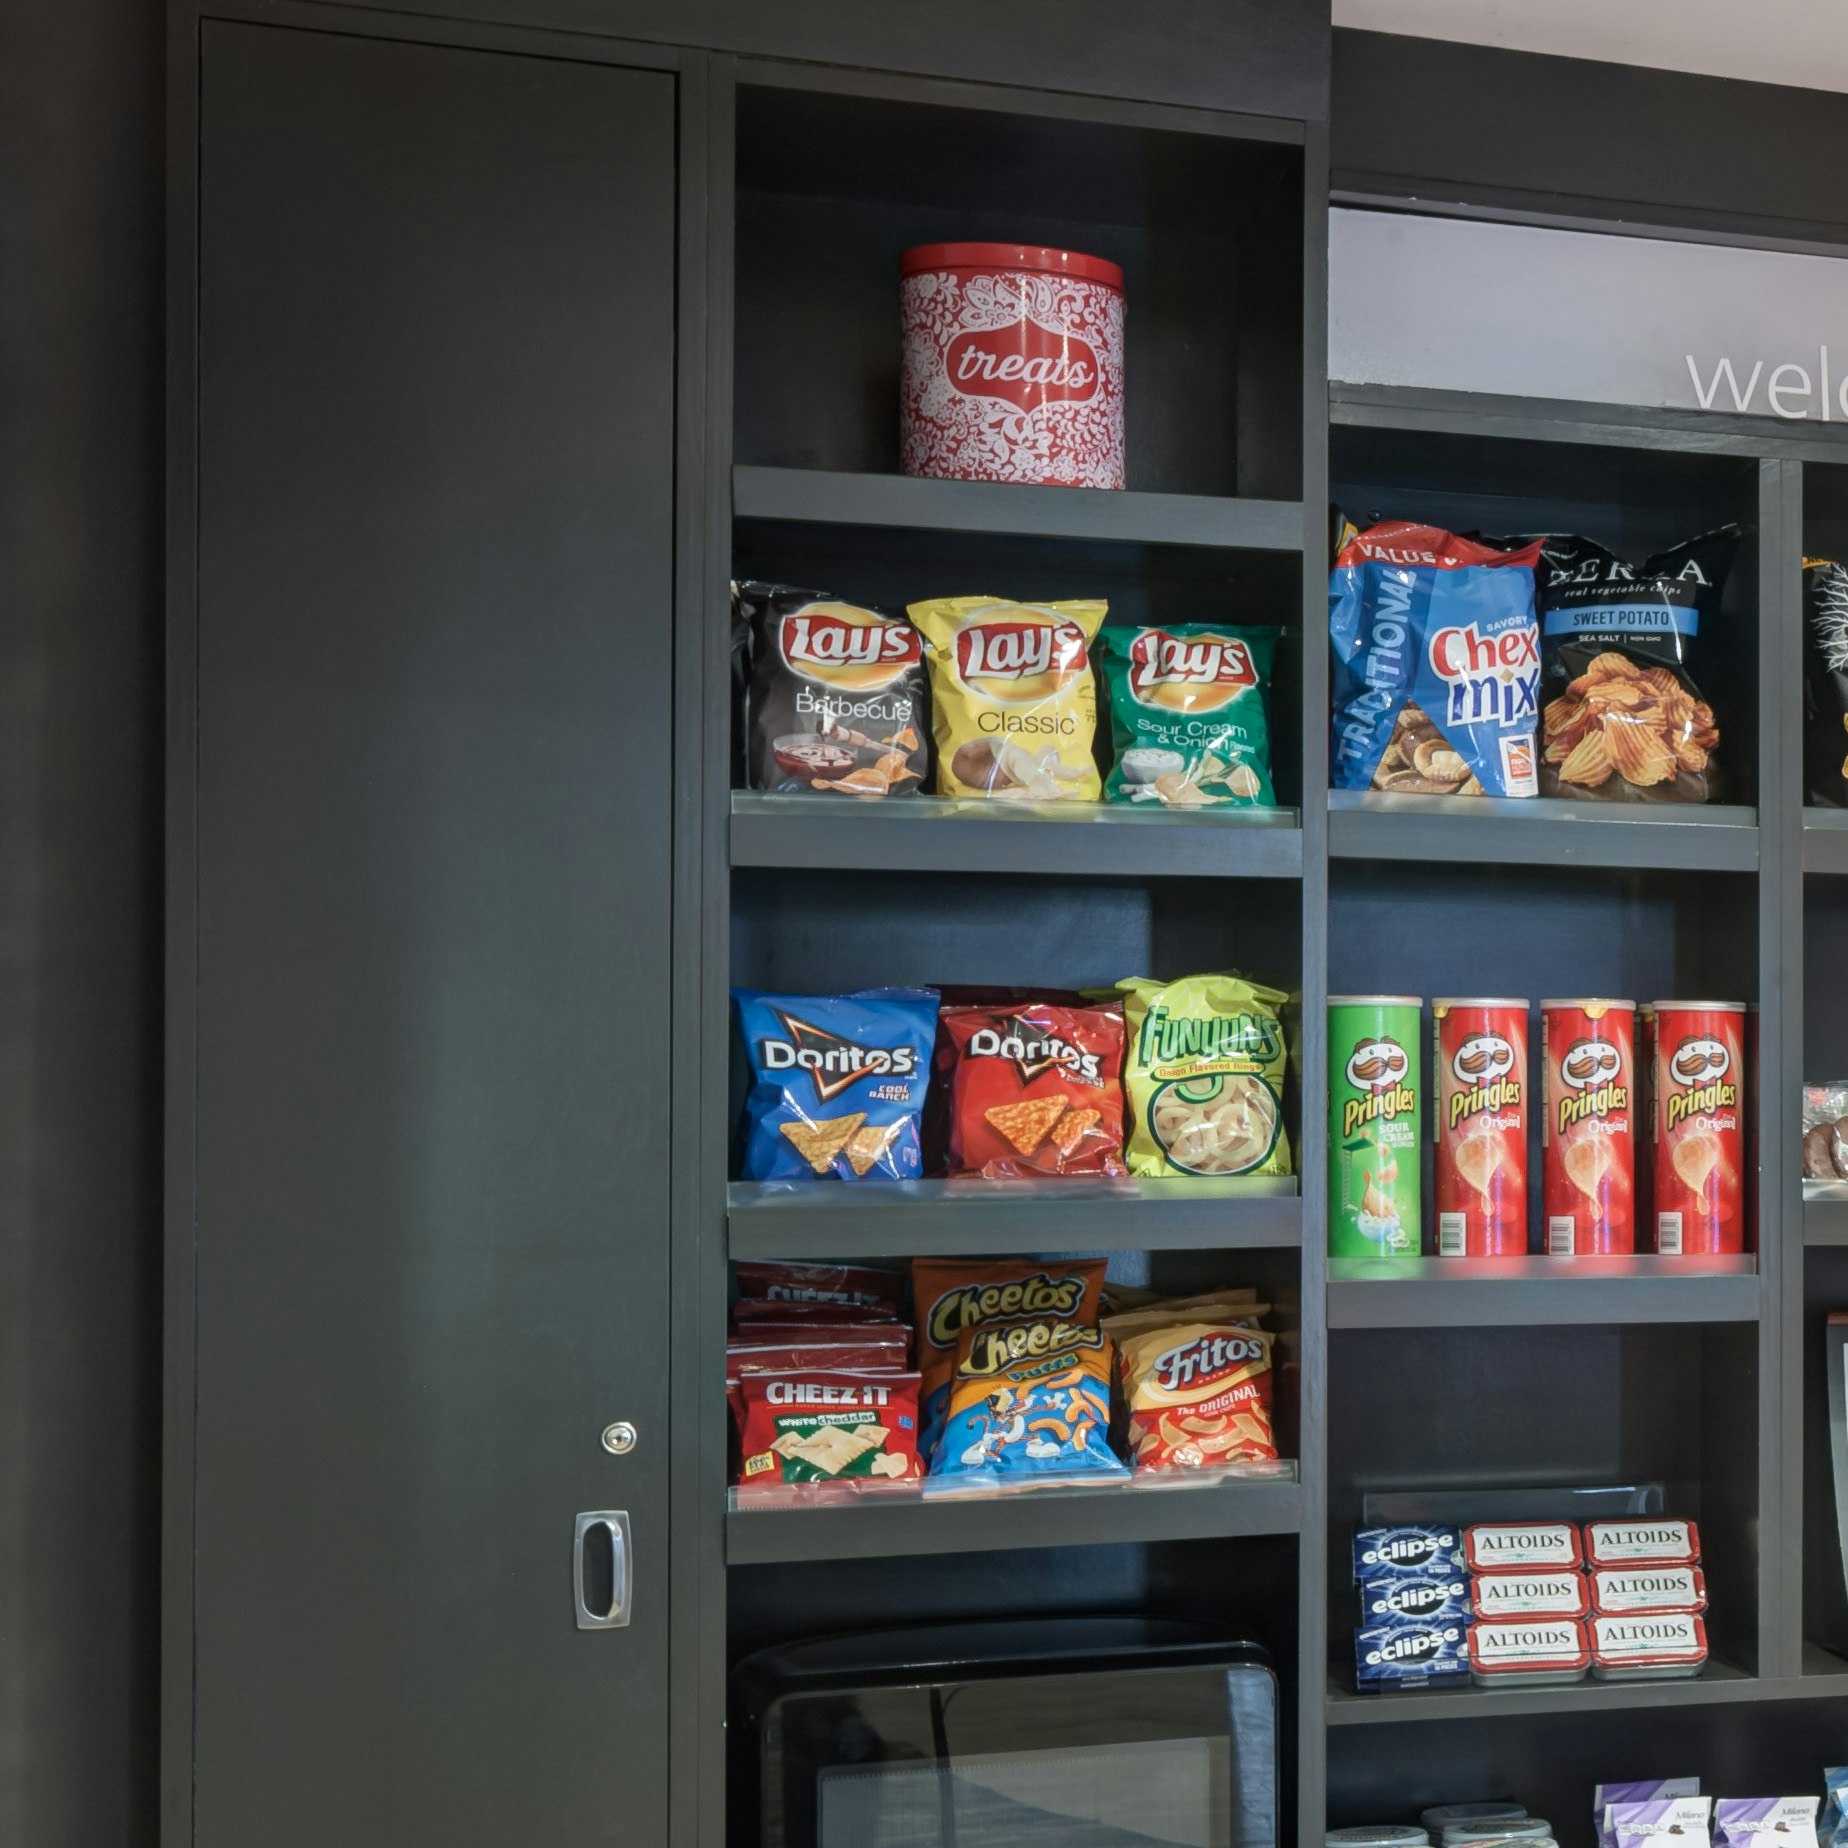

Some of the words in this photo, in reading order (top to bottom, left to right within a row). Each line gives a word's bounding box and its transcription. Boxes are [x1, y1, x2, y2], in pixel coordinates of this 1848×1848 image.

[955, 344, 1095, 389] treats
[1360, 544, 1435, 565] VALUE
[1592, 584, 1646, 597] vegetable
[1486, 615, 1528, 633] SAVORY
[1573, 610, 1615, 626] SWEET
[1618, 609, 1669, 625] POTATO
[789, 617, 912, 666] Lay's
[964, 621, 1084, 681] Lay's
[1432, 625, 1539, 676] Chex
[1579, 634, 1595, 642] SEA
[1598, 634, 1620, 642] SALT
[1337, 568, 1418, 762] TRADITIONAL
[796, 693, 911, 721] Barbecue
[1452, 667, 1538, 723] mix
[978, 711, 1076, 736] Classic
[1136, 719, 1182, 737] Sour
[1186, 721, 1247, 739] Cream
[1157, 734, 1170, 744] &
[765, 1039, 914, 1075] Doritos
[970, 1028, 1101, 1079] Doritos
[1159, 1066, 1186, 1078] Onion
[1188, 1062, 1230, 1077] Flavored
[869, 1090, 910, 1102] RANCH
[878, 1084, 910, 1095] COOL
[1449, 1077, 1521, 1130] Pringles
[1344, 1085, 1415, 1136] Pringles
[1379, 1122, 1408, 1133] SOUR
[933, 1278, 1082, 1344] Cheetos
[959, 1321, 1103, 1377] Cheetos
[1154, 1335, 1263, 1390] Fritos
[1007, 1354, 1078, 1383] PUFFS
[1176, 1405, 1196, 1417] The
[1199, 1384, 1260, 1418] ORIGINAL
[1361, 1533, 1454, 1565] eclipse
[1482, 1534, 1565, 1549] ALTOIDS
[1601, 1530, 1682, 1545] ALTOIDS
[1371, 1582, 1465, 1614] eclipse
